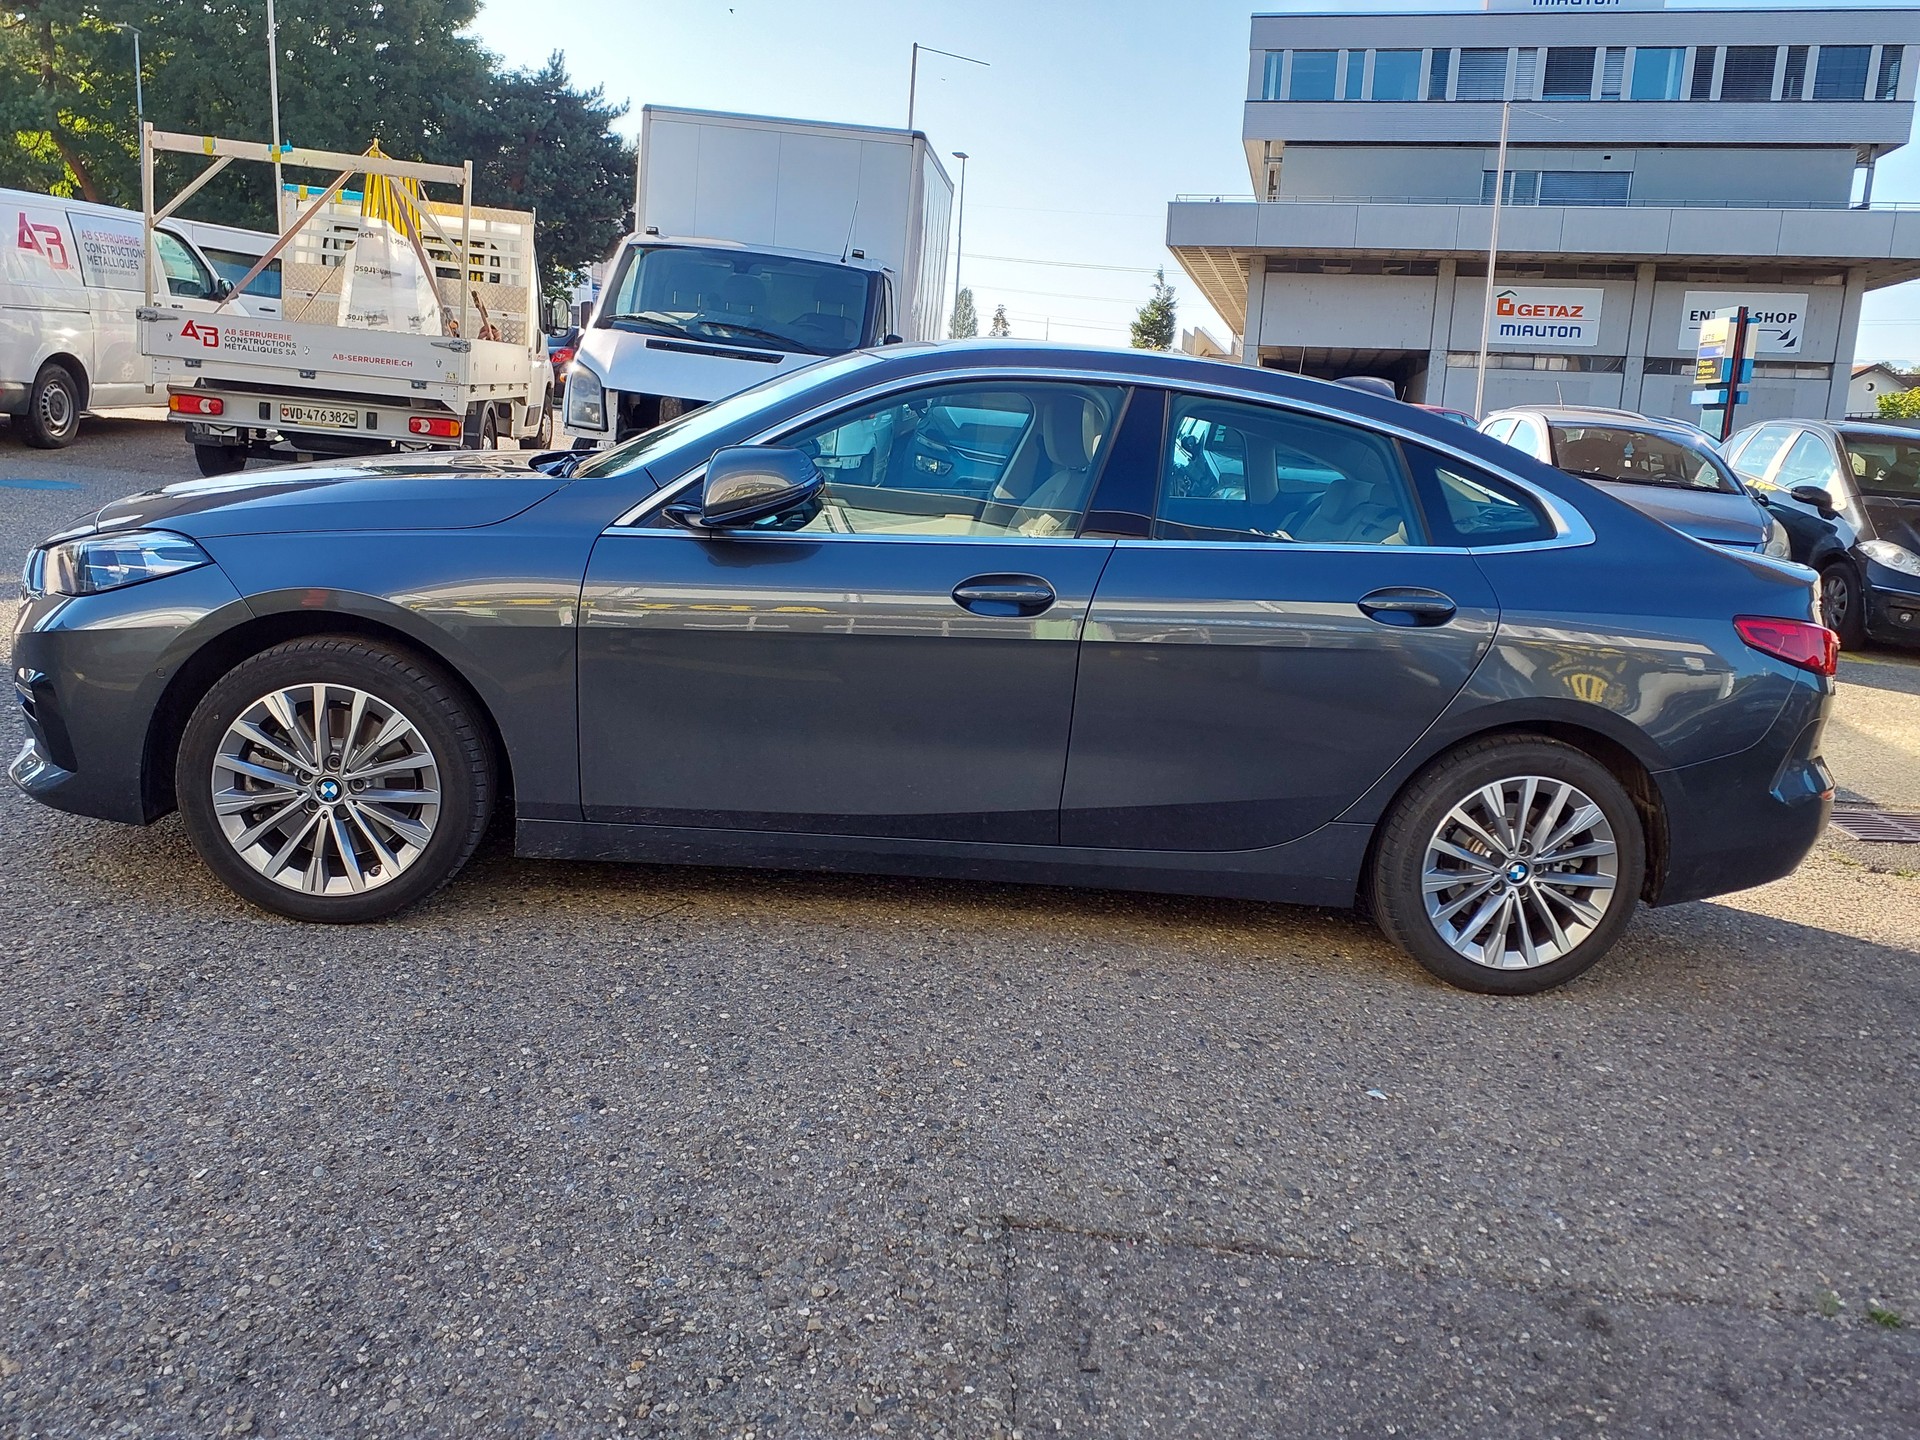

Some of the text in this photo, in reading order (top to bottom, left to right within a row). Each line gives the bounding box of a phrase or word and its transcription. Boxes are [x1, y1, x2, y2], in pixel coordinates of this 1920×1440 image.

[81, 230, 141, 247] AB SERRURERIE
[86, 253, 139, 270] MÉTALLIQUES
[1517, 304, 1584, 318] GETAZ
[1754, 311, 1798, 324] SHOP
[180, 320, 219, 348] AB
[224, 328, 292, 341] AB SERRURERIE
[1500, 324, 1581, 338] MIAUTON
[224, 336, 297, 349] CONSTRUCTIONS
[224, 343, 297, 356] MÉTALLIQUES SA
[332, 353, 413, 367] AB-SERRURERIE.CH
